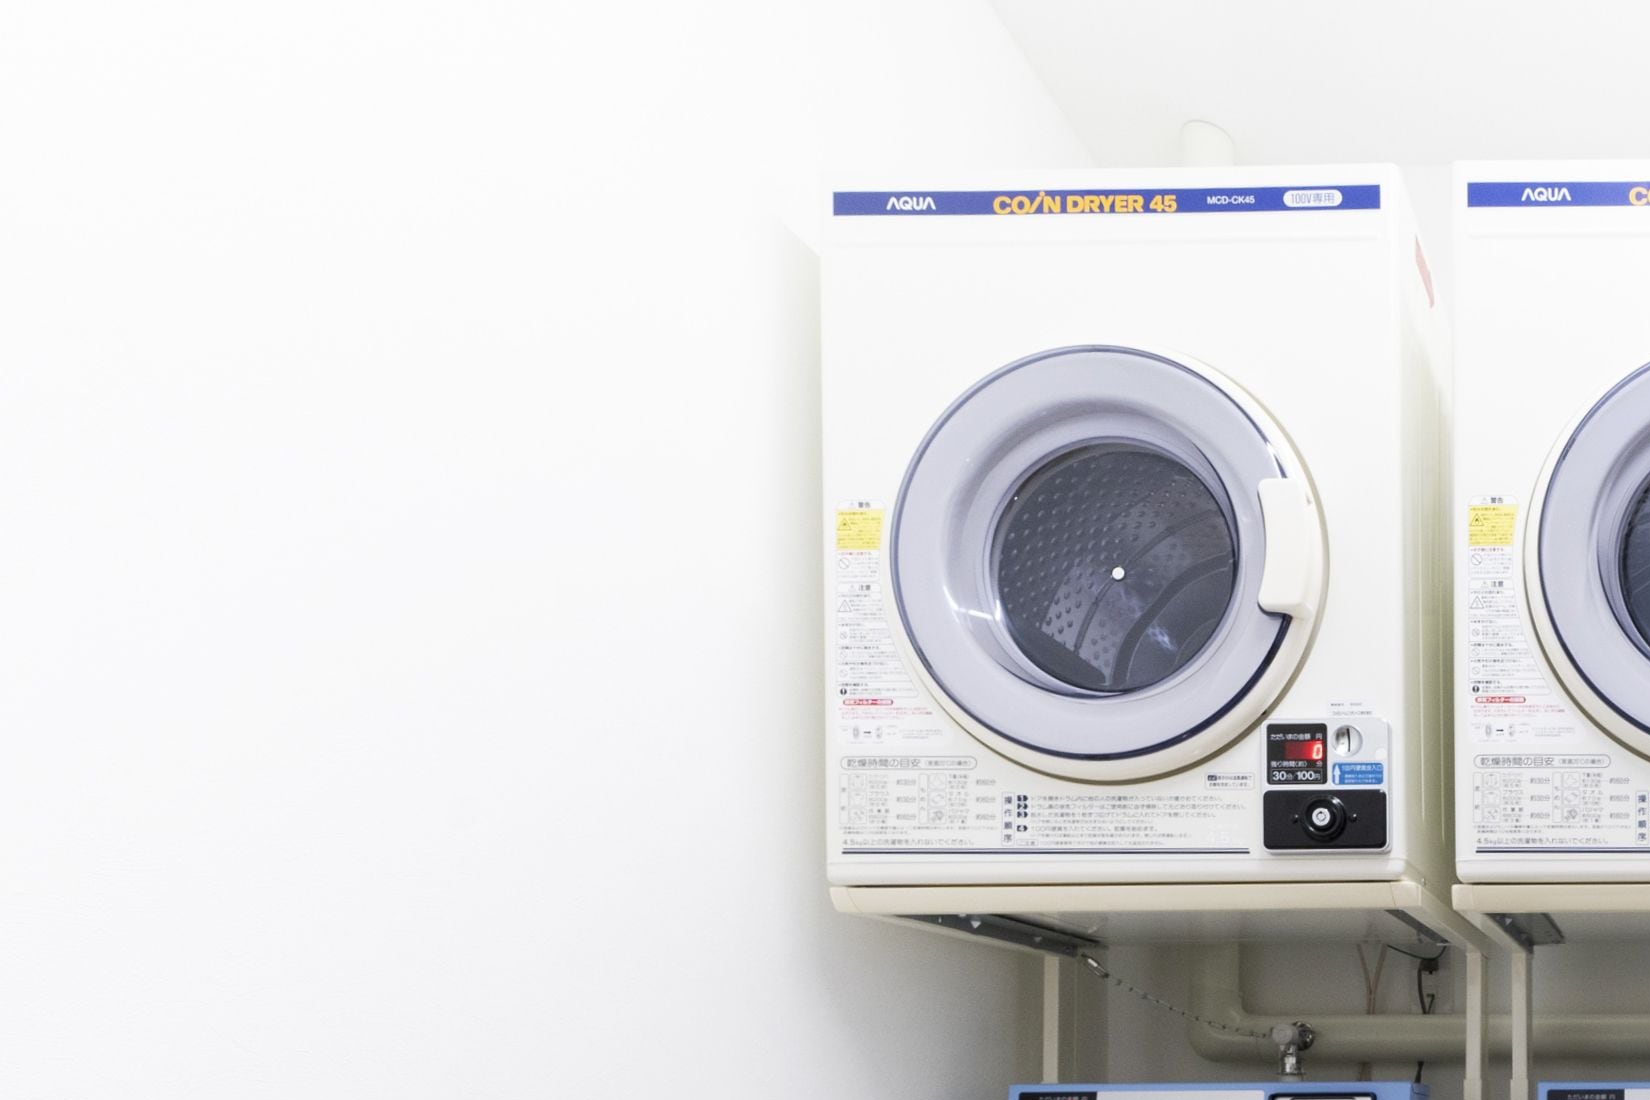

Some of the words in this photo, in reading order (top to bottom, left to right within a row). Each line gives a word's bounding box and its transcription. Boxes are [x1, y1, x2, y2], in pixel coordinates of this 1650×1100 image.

[1207, 195, 1256, 205] MCD-CK45
[1521, 187, 1572, 202] AQUA
[886, 196, 937, 211] AQUA
[1067, 195, 1144, 213] DRYER
[1150, 195, 1178, 212] 45
[1312, 743, 1323, 759] 0
